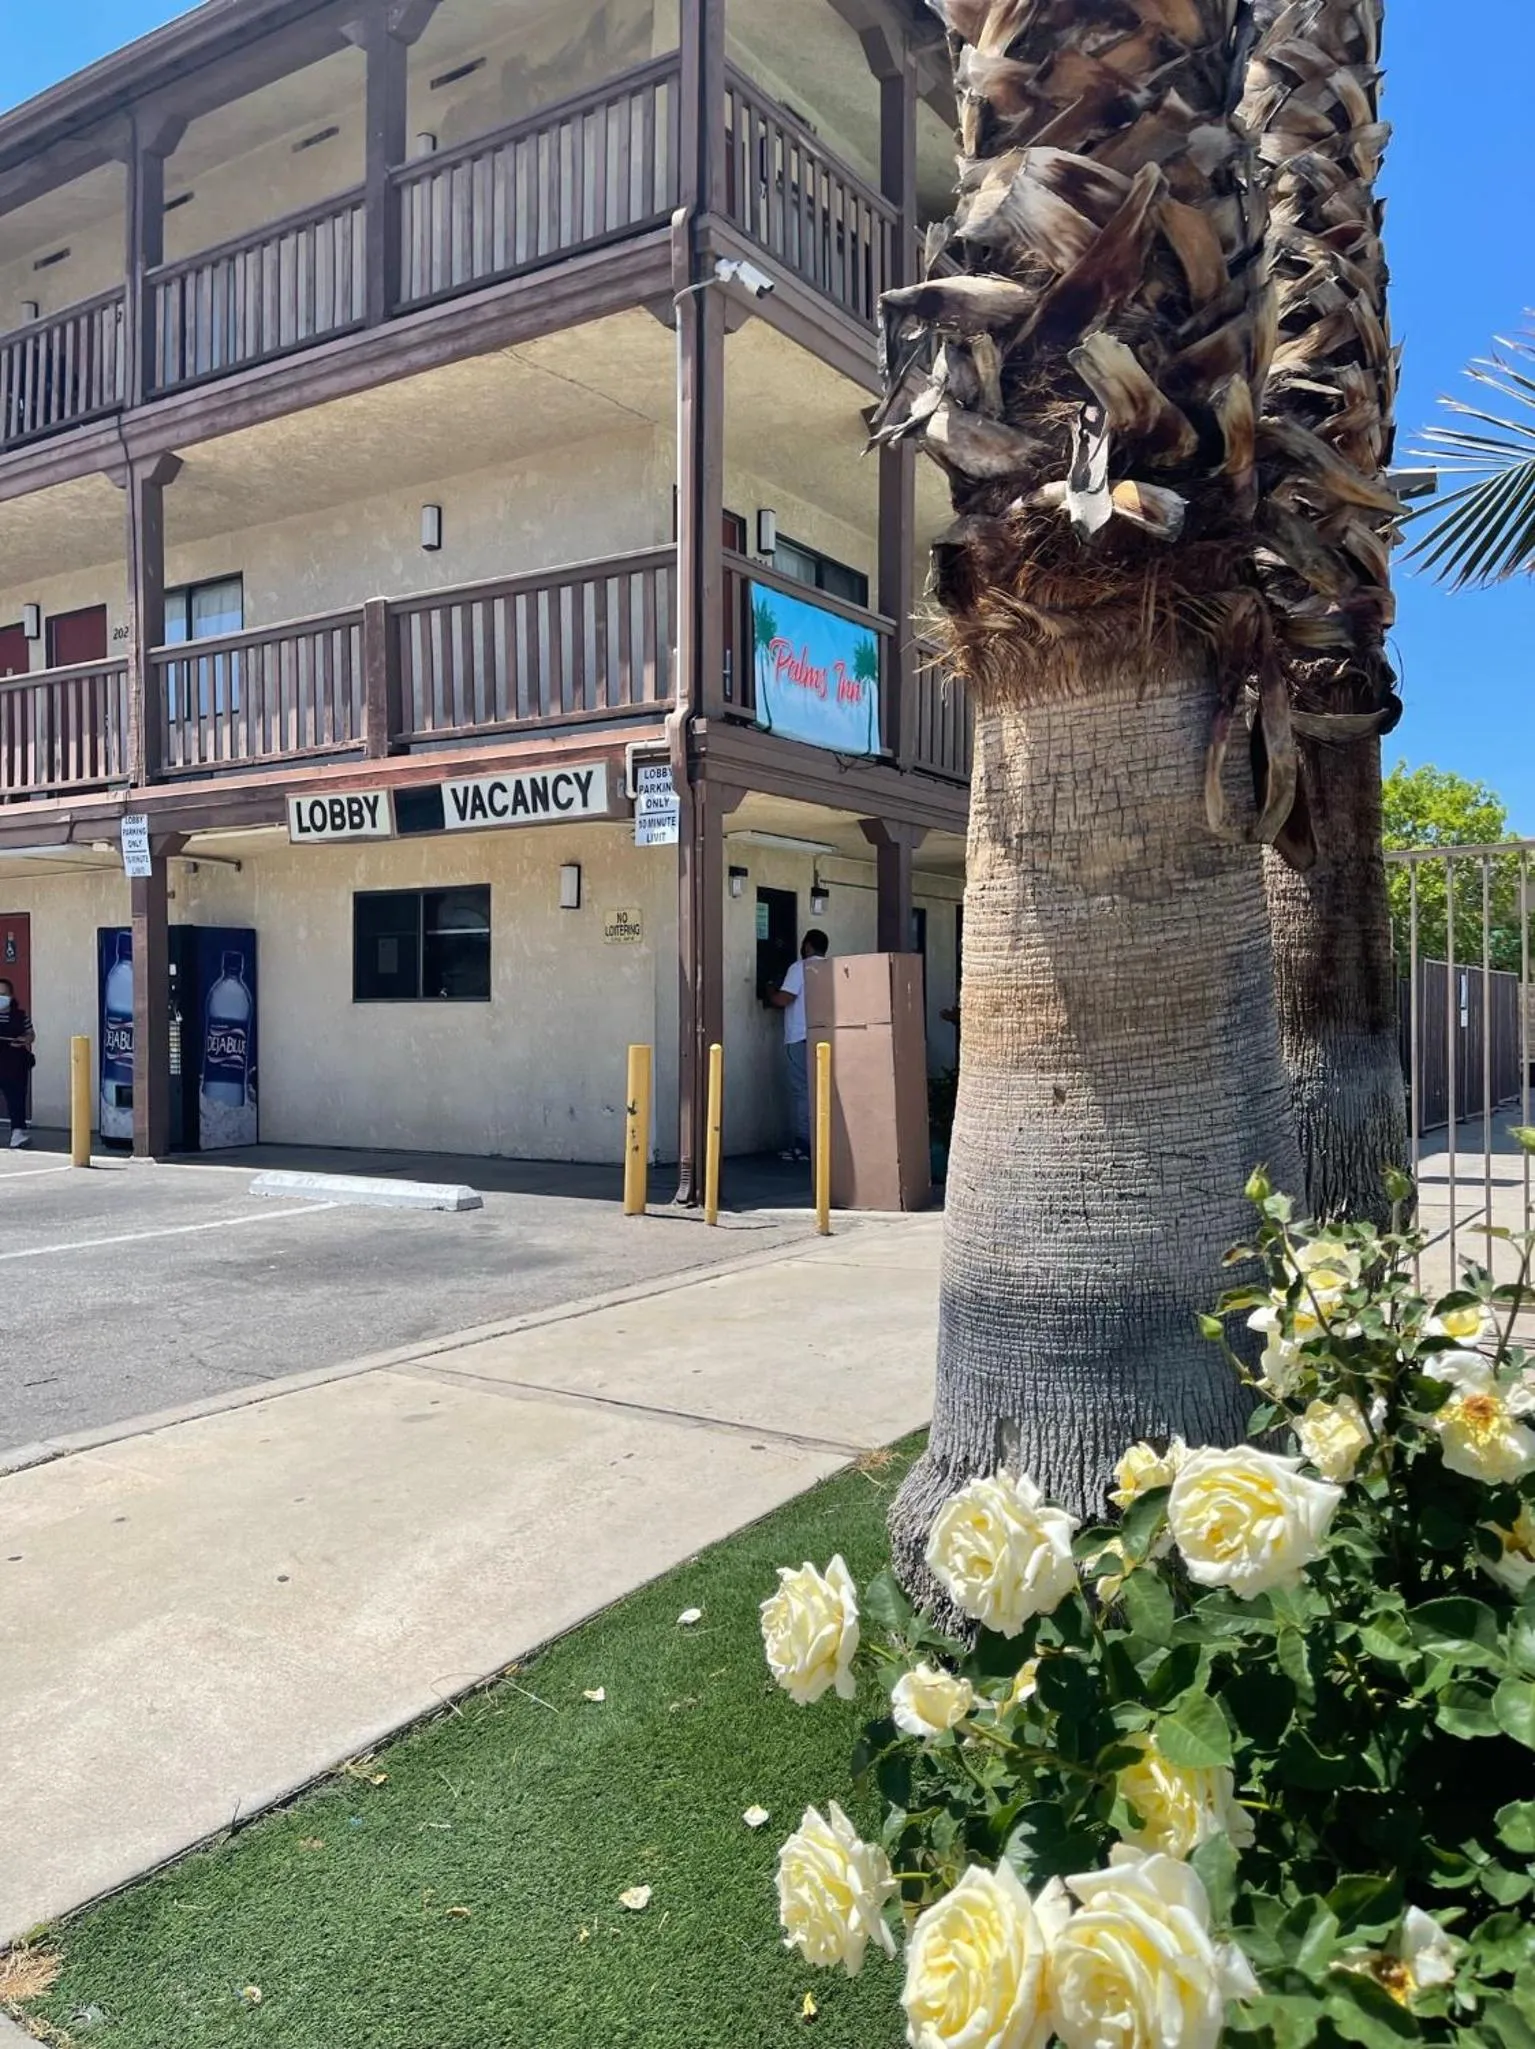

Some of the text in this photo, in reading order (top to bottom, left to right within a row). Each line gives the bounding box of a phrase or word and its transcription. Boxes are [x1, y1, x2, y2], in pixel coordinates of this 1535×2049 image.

[113, 626, 129, 640] 202
[769, 637, 862, 704] Palms Inn
[639, 782, 672, 795] PARKIN
[450, 770, 594, 822] VACANCY
[645, 798, 670, 809] ONLY
[295, 794, 380, 834] LOBBY
[648, 816, 676, 829] MINUTE
[616, 911, 628, 924] NO
[604, 923, 640, 937] LOITERING
